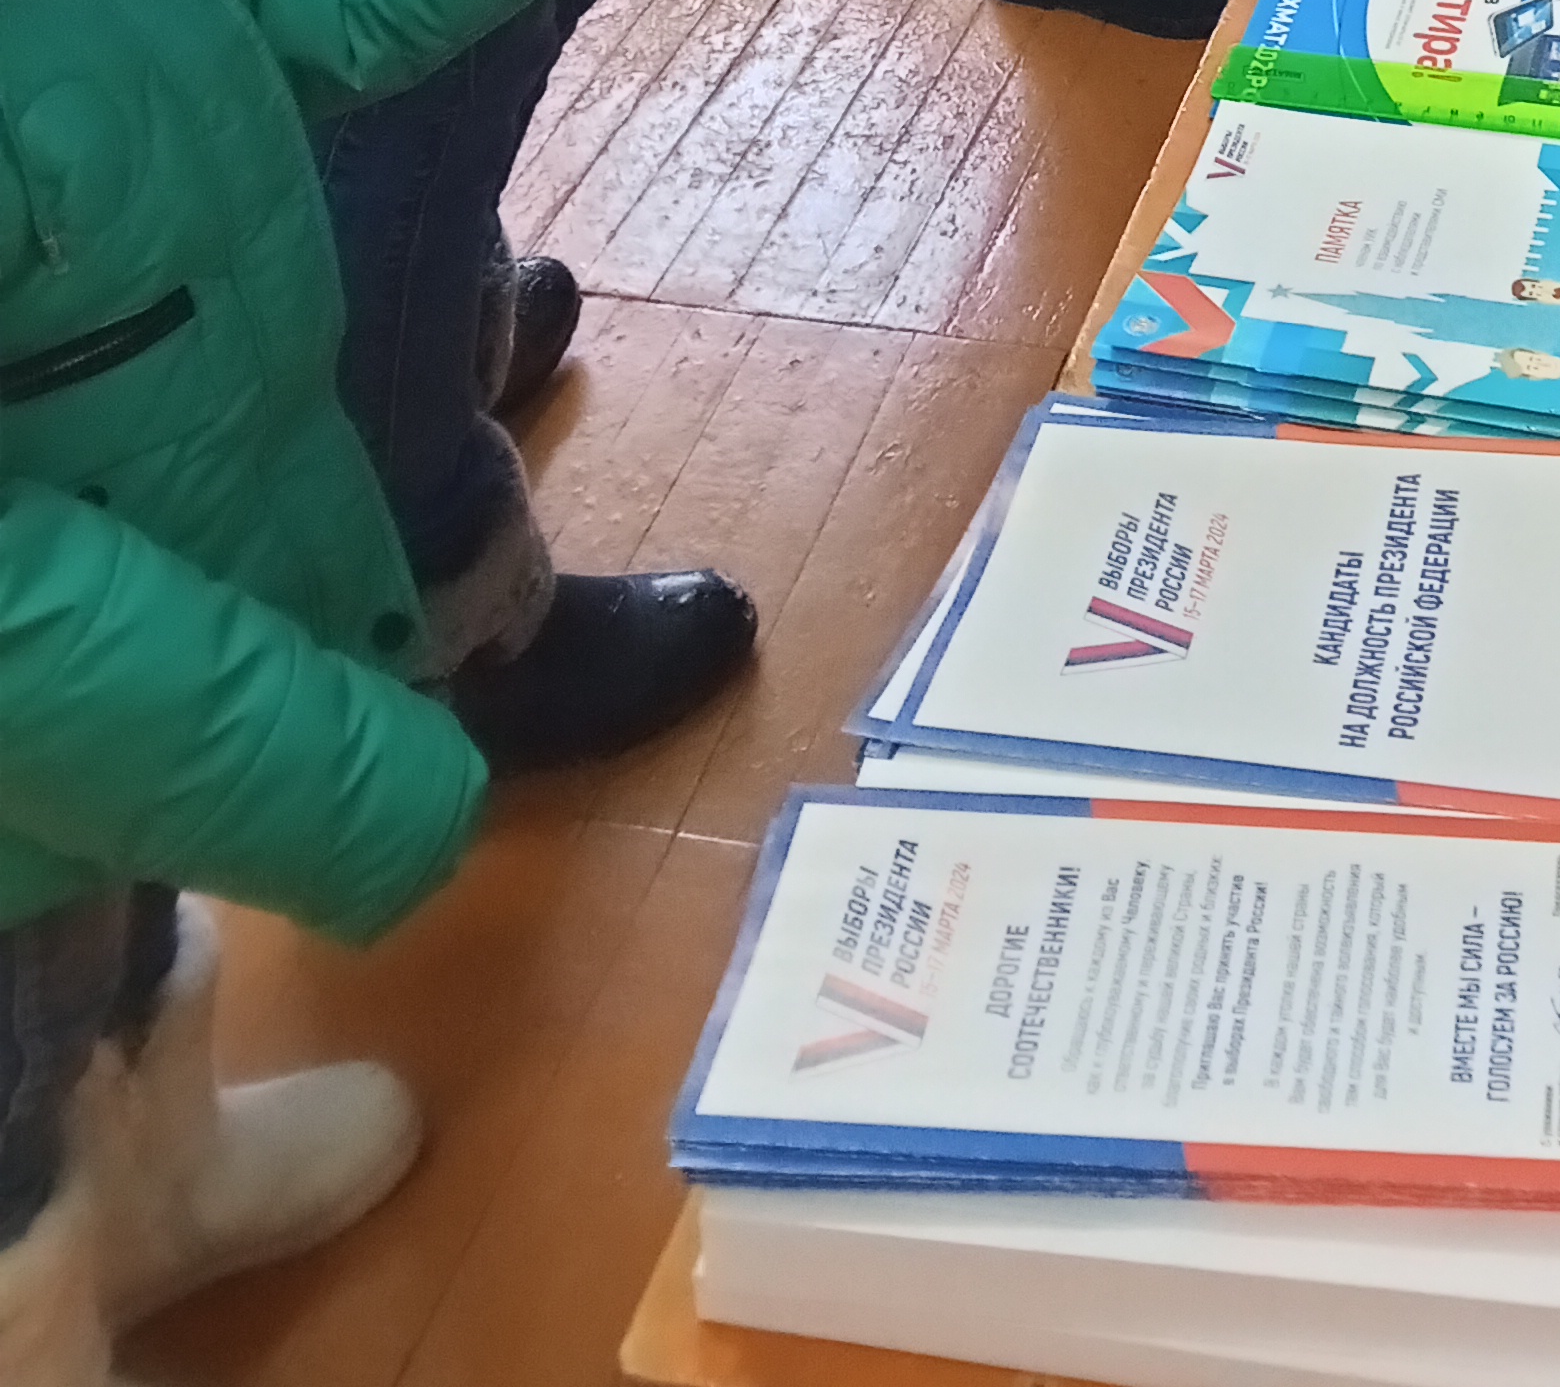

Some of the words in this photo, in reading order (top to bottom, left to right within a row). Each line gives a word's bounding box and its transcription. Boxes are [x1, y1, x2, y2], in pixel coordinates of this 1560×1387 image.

[1314, 200, 1362, 263] ПАМЯТКА
[1098, 512, 1139, 590] ВЫБОРЫ
[1126, 492, 1177, 600] ПРЕЗИДЕНТА
[1192, 545, 1220, 588] МАРТА
[1205, 513, 1228, 546] 2024
[1374, 474, 1420, 597] ПРЕЗИДЕНТА
[1154, 543, 1192, 612] РОССИИ
[1313, 551, 1363, 665] КАНДИДАТЫ
[1388, 615, 1437, 739] РОССИЙСКОЙ
[1414, 489, 1459, 610] ФЕДЕРАЦИИ
[1346, 603, 1396, 719] ДОЛЖНОСТЬ
[1338, 723, 1370, 748] НА
[833, 865, 878, 957] ВЫБОРЫ
[862, 839, 918, 969] ПРЕЗИДЕНТА
[932, 901, 960, 952] МАРТА
[948, 861, 971, 900] 2024
[1100, 877, 1120, 902] Вас
[1220, 873, 1248, 927] участие
[892, 899, 932, 978] РОССИИ
[984, 924, 1029, 1018] ДОРОГИЕ
[1214, 929, 1235, 983] принять
[1231, 936, 1259, 1014] Президента
[1245, 881, 1267, 933] России!
[1459, 922, 1484, 972] СИЛА
[1495, 890, 1522, 975] РОССИЮ!
[1008, 866, 1079, 1078] СООТЕЧЕСТВЕННИКИ!
[1206, 986, 1225, 1010] Вас
[1457, 976, 1481, 1009] МЫ
[1493, 980, 1517, 1003] ЗА
[1449, 1014, 1478, 1083] ВМЕСТЕ
[1486, 1007, 1514, 1101] ГОЛОСУЕМ
